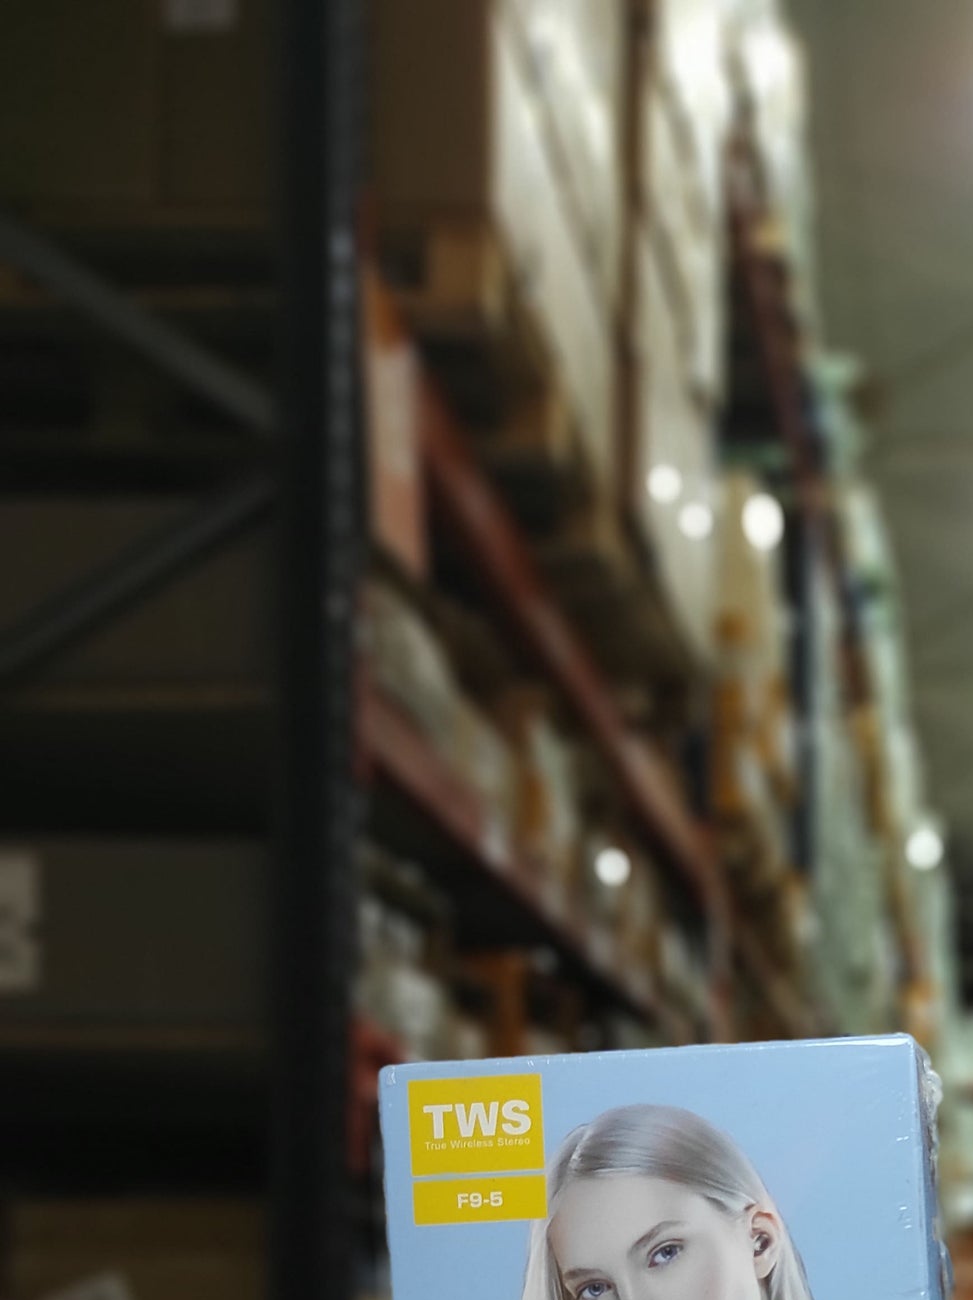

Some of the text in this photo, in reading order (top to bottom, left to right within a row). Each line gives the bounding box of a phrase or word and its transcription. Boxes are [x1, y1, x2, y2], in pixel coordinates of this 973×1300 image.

[422, 1099, 532, 1140] TWS
[425, 1137, 531, 1151] True Wireless Stereo
[457, 1191, 504, 1209] F9-5
